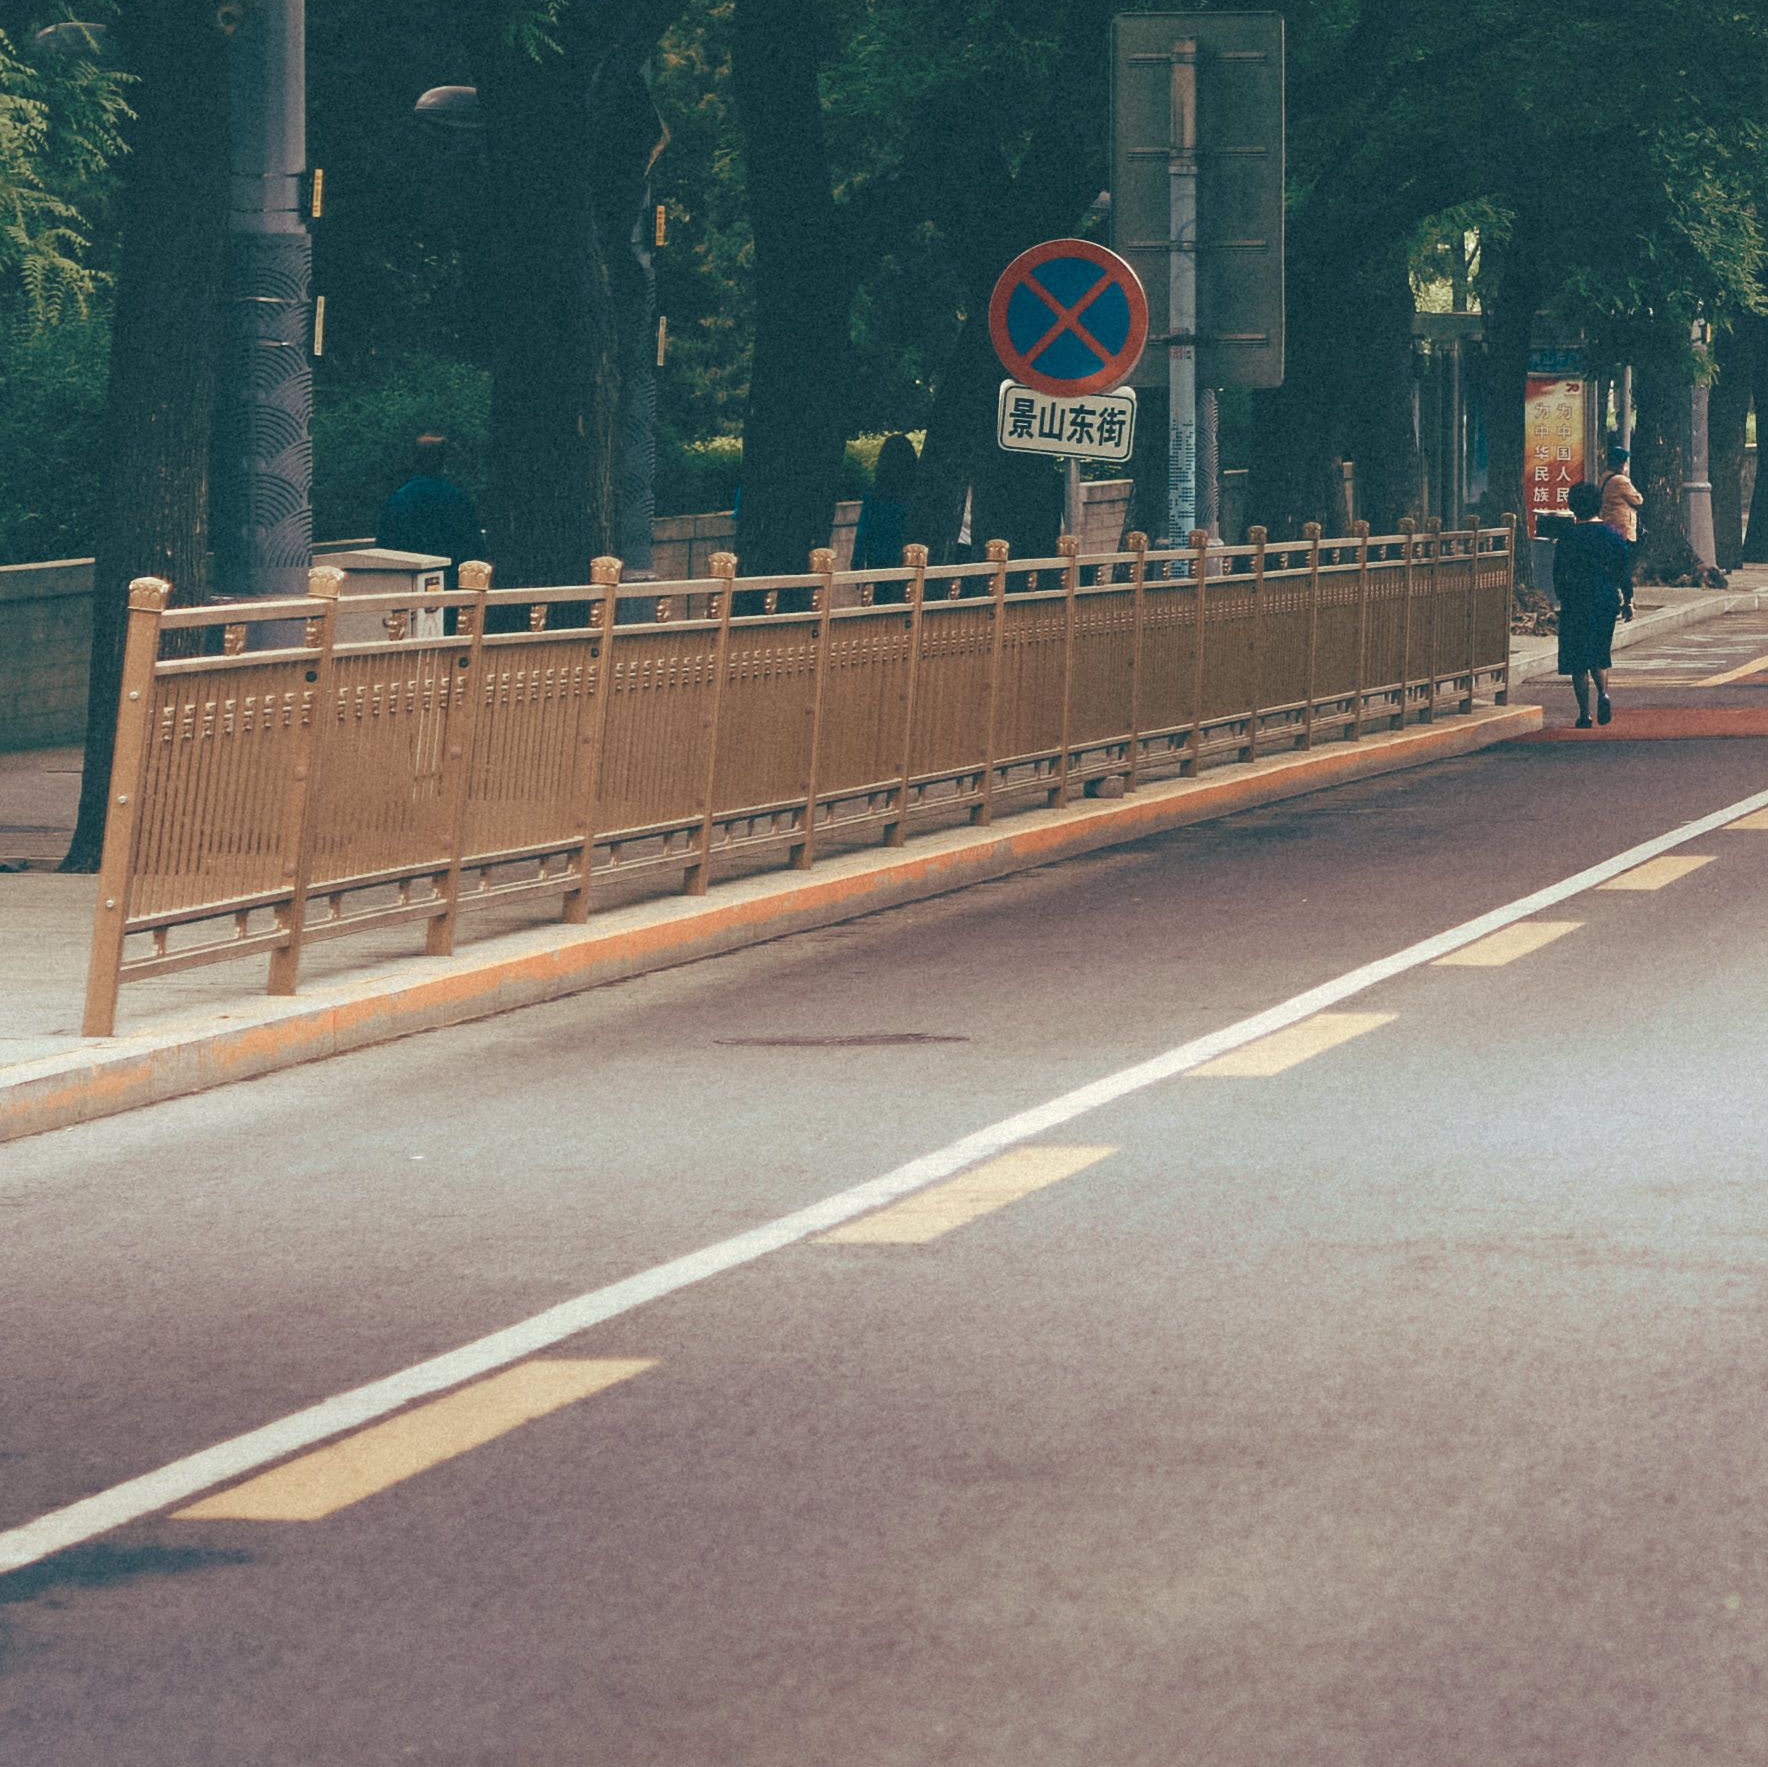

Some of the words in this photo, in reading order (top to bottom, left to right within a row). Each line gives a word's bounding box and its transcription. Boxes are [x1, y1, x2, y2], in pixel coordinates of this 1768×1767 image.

[1008, 397, 1127, 448] 景山东街
[1533, 403, 1549, 511] 为中华民族
[1556, 403, 1572, 511] 为中国人民
